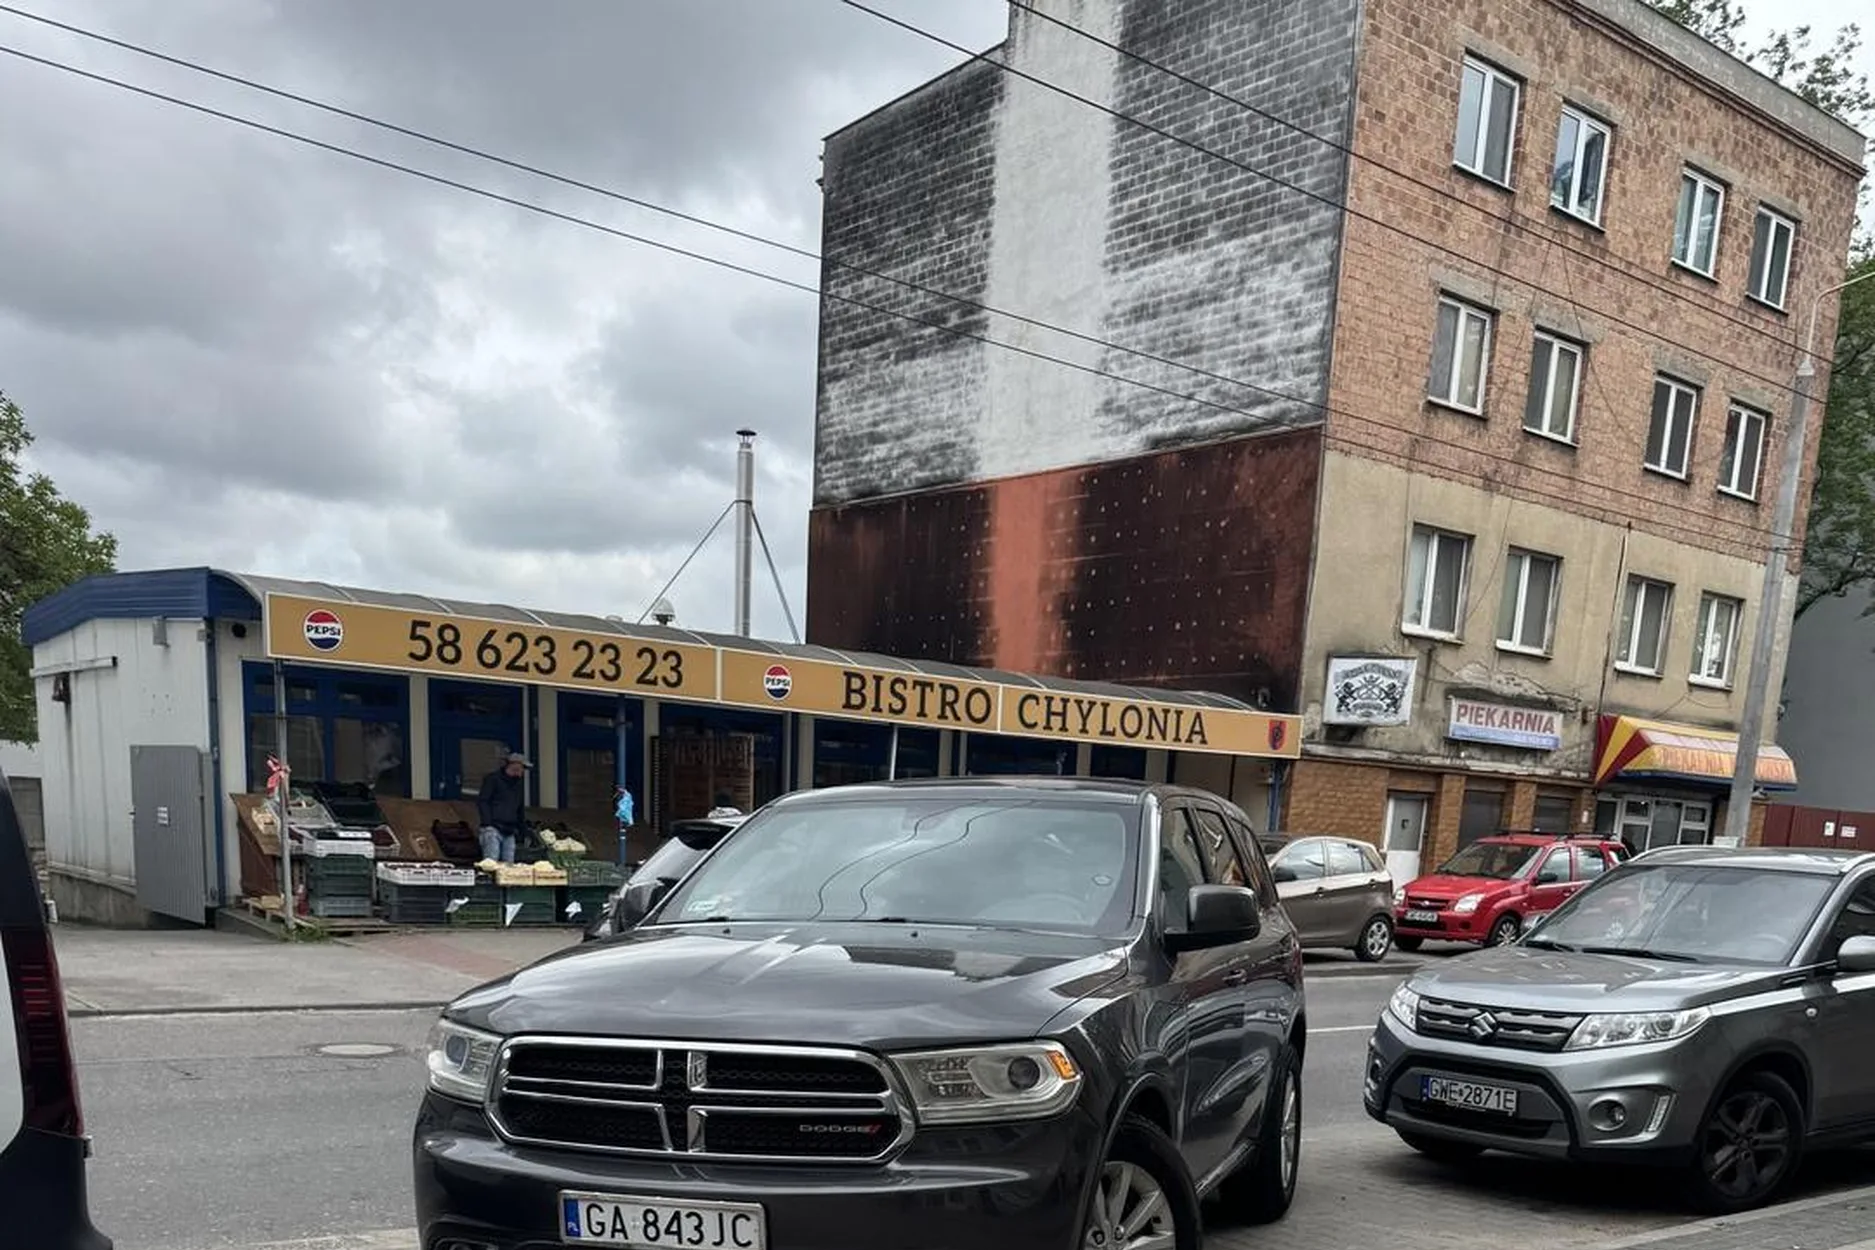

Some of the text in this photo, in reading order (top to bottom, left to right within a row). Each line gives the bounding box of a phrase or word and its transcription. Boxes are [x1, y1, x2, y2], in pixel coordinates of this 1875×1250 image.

[306, 624, 341, 636] PEPSI
[408, 619, 684, 688] 58 623 23 23
[765, 676, 790, 687] PEPSI
[842, 671, 1209, 746] BISTRO CHYLONIA
[1455, 703, 1556, 734] PIEKARNIA
[1429, 1079, 1515, 1111] GWE 2871E
[799, 1124, 870, 1133] DODGE
[585, 1203, 753, 1248] GA 843JC
